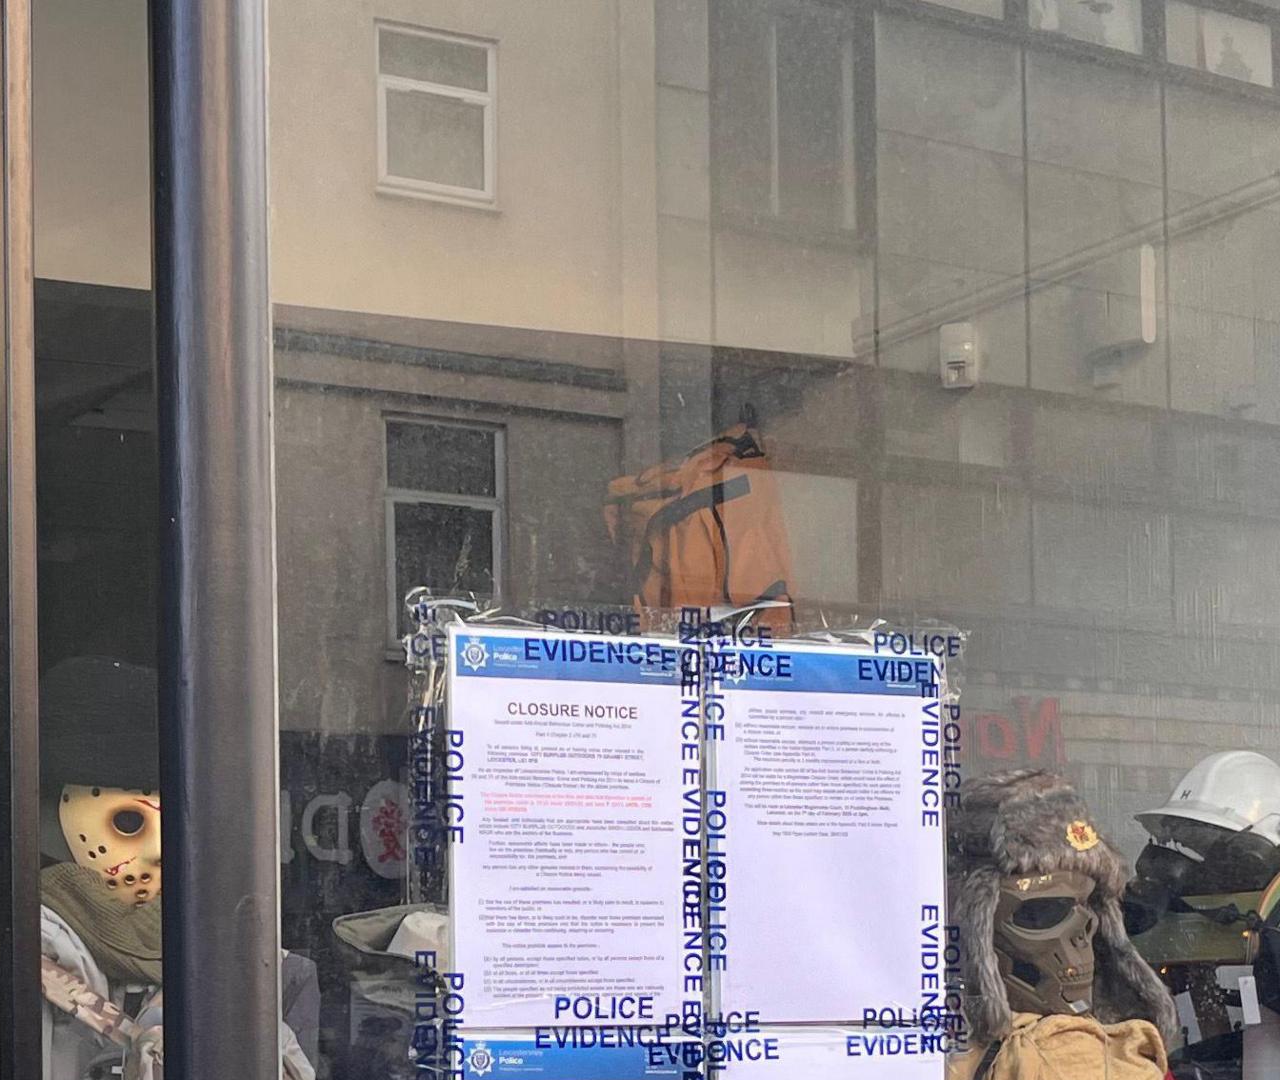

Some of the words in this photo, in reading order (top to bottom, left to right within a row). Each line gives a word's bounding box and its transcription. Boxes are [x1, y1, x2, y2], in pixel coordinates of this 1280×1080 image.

[541, 609, 641, 637] POLICE
[874, 632, 961, 657] POLICE
[508, 702, 579, 718] CLOSURE
[586, 705, 638, 720] NOTICE
[921, 682, 940, 828] EVIDENCE
[944, 704, 962, 808] POLICE
[443, 729, 465, 844] POLICE
[554, 996, 655, 1021] POLICE
[499, 1056, 524, 1066] Police
